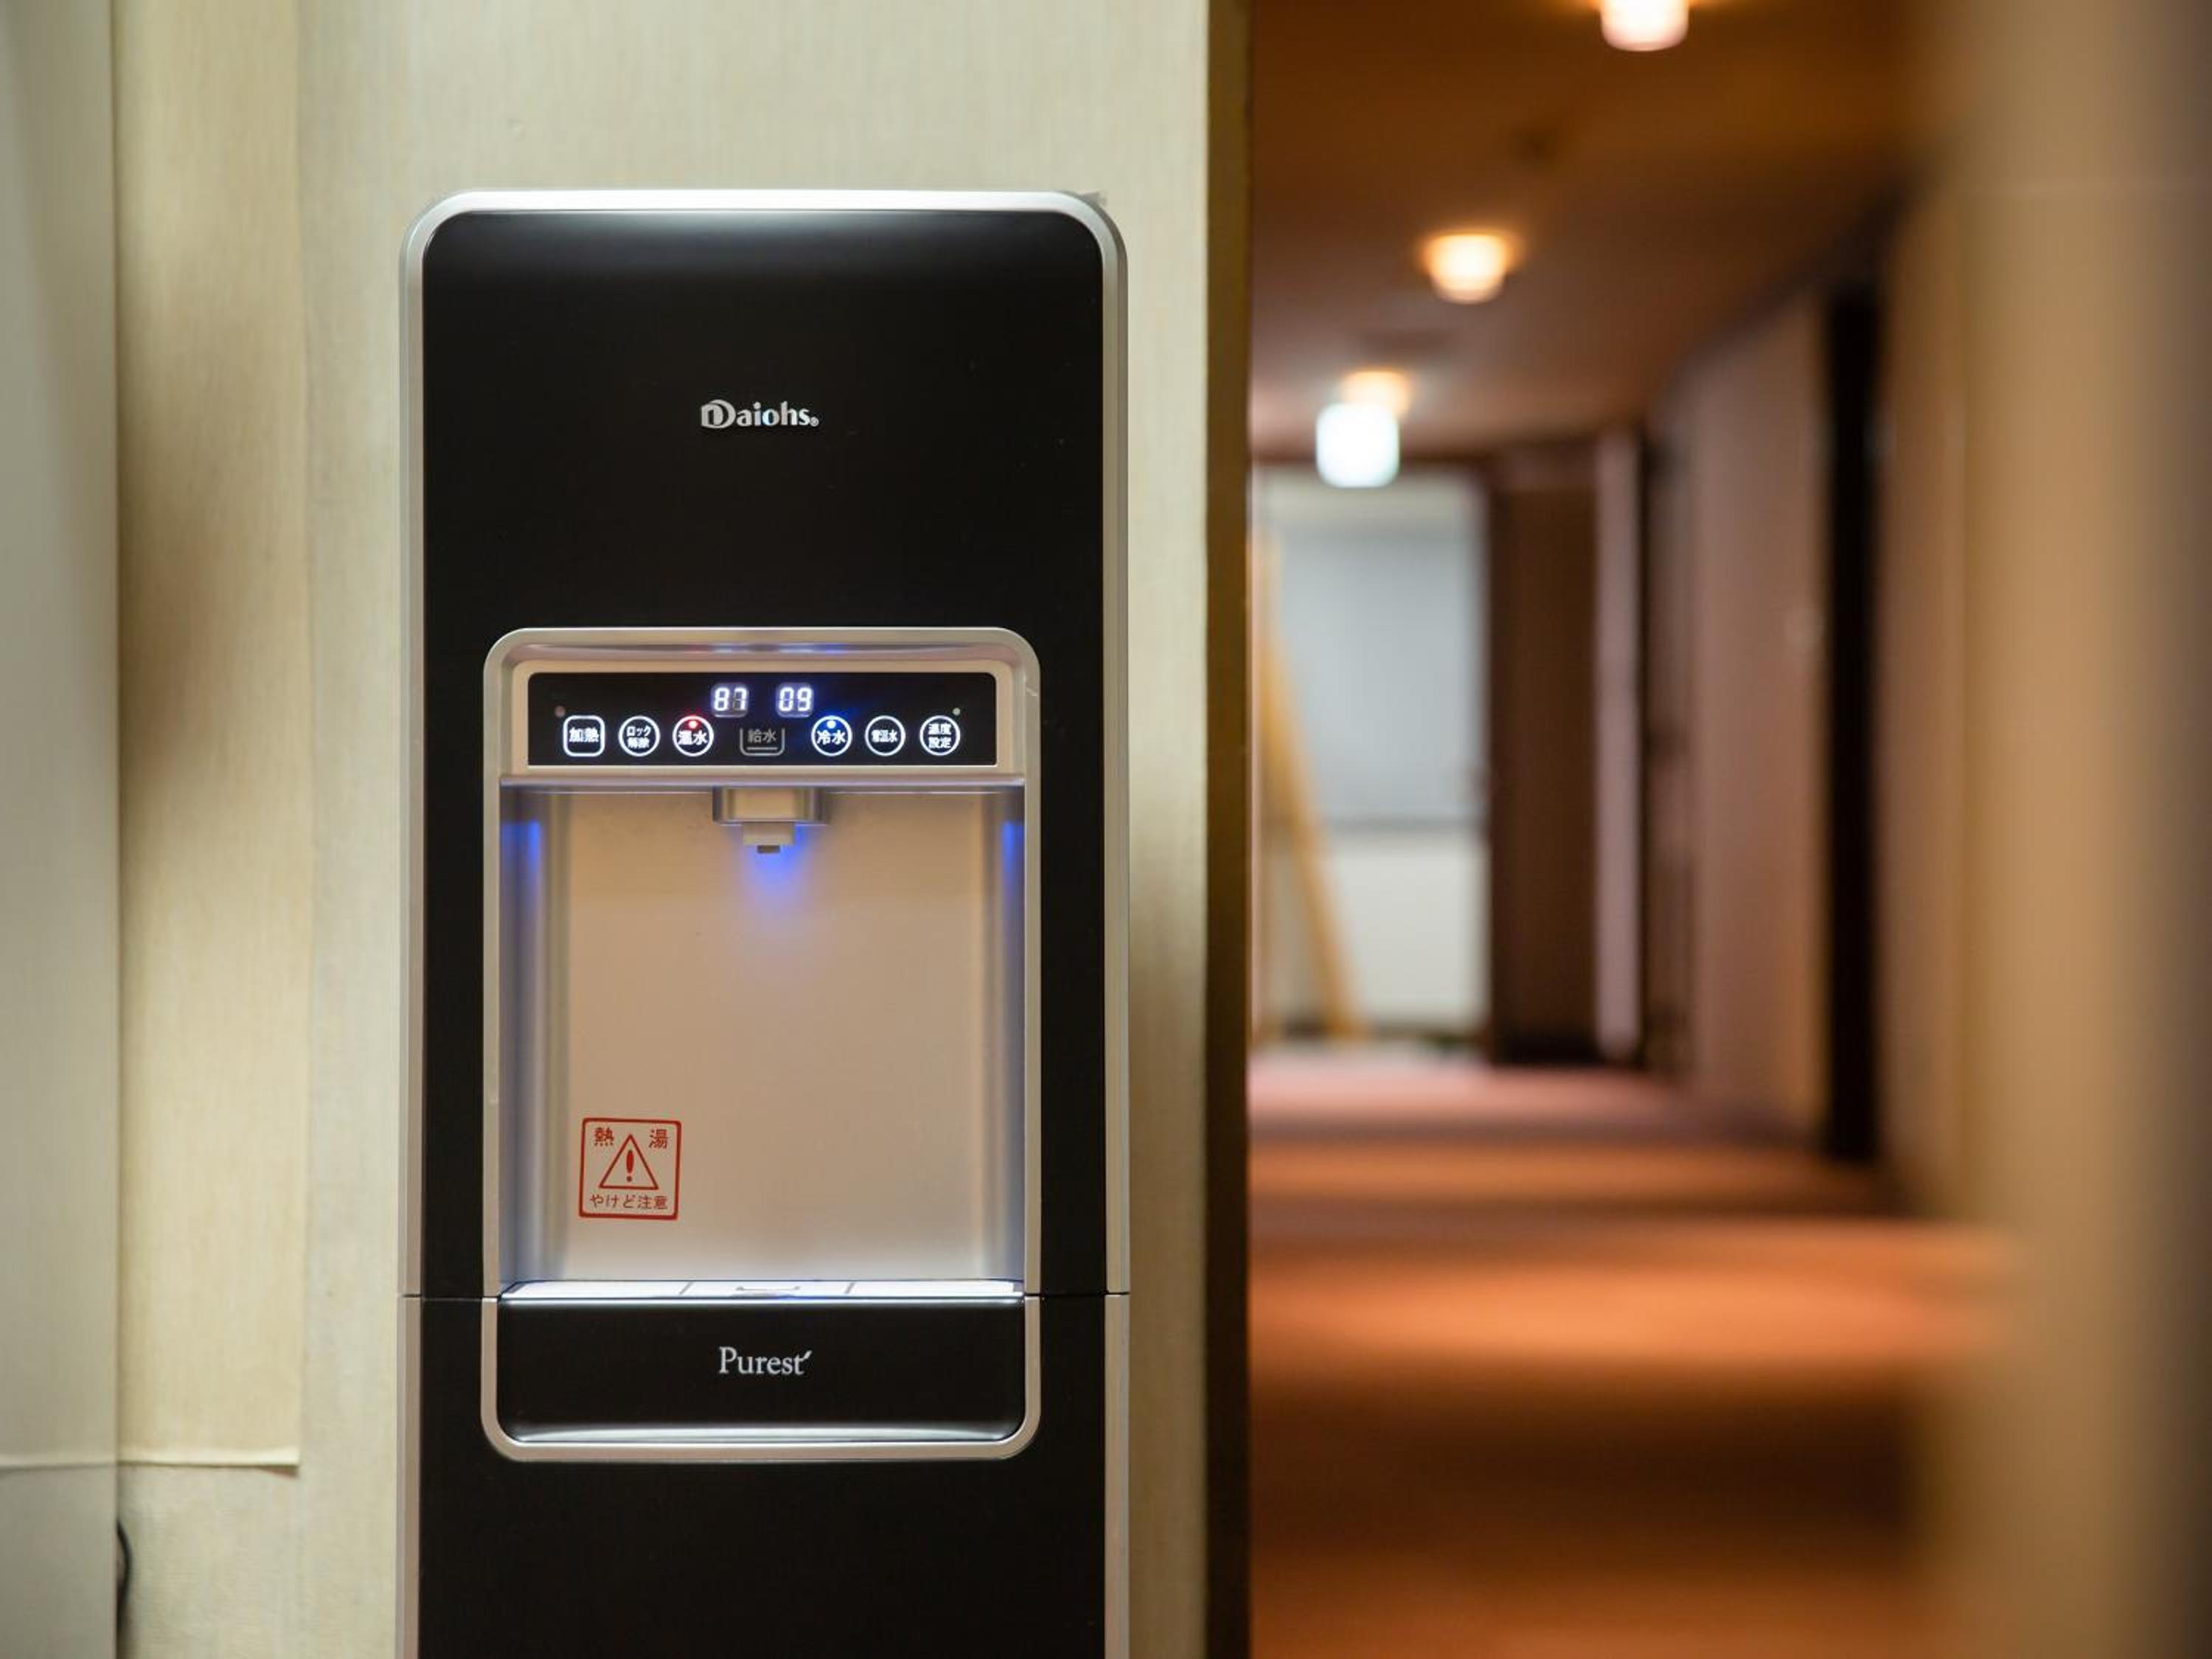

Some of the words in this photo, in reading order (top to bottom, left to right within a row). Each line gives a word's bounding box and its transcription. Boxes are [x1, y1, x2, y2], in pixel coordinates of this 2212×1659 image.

[713, 686, 748, 712] 87
[778, 686, 813, 712] 09
[568, 726, 599, 743] 加熱
[626, 726, 652, 737] ロック
[678, 730, 708, 745] 温水
[747, 729, 776, 743] 給水
[816, 730, 846, 745] 冷水
[928, 737, 952, 749] 設定
[594, 1127, 614, 1147] 熱
[648, 1128, 669, 1149] 湯
[589, 1193, 668, 1211] やけど注意
[718, 1346, 813, 1376] Purest
